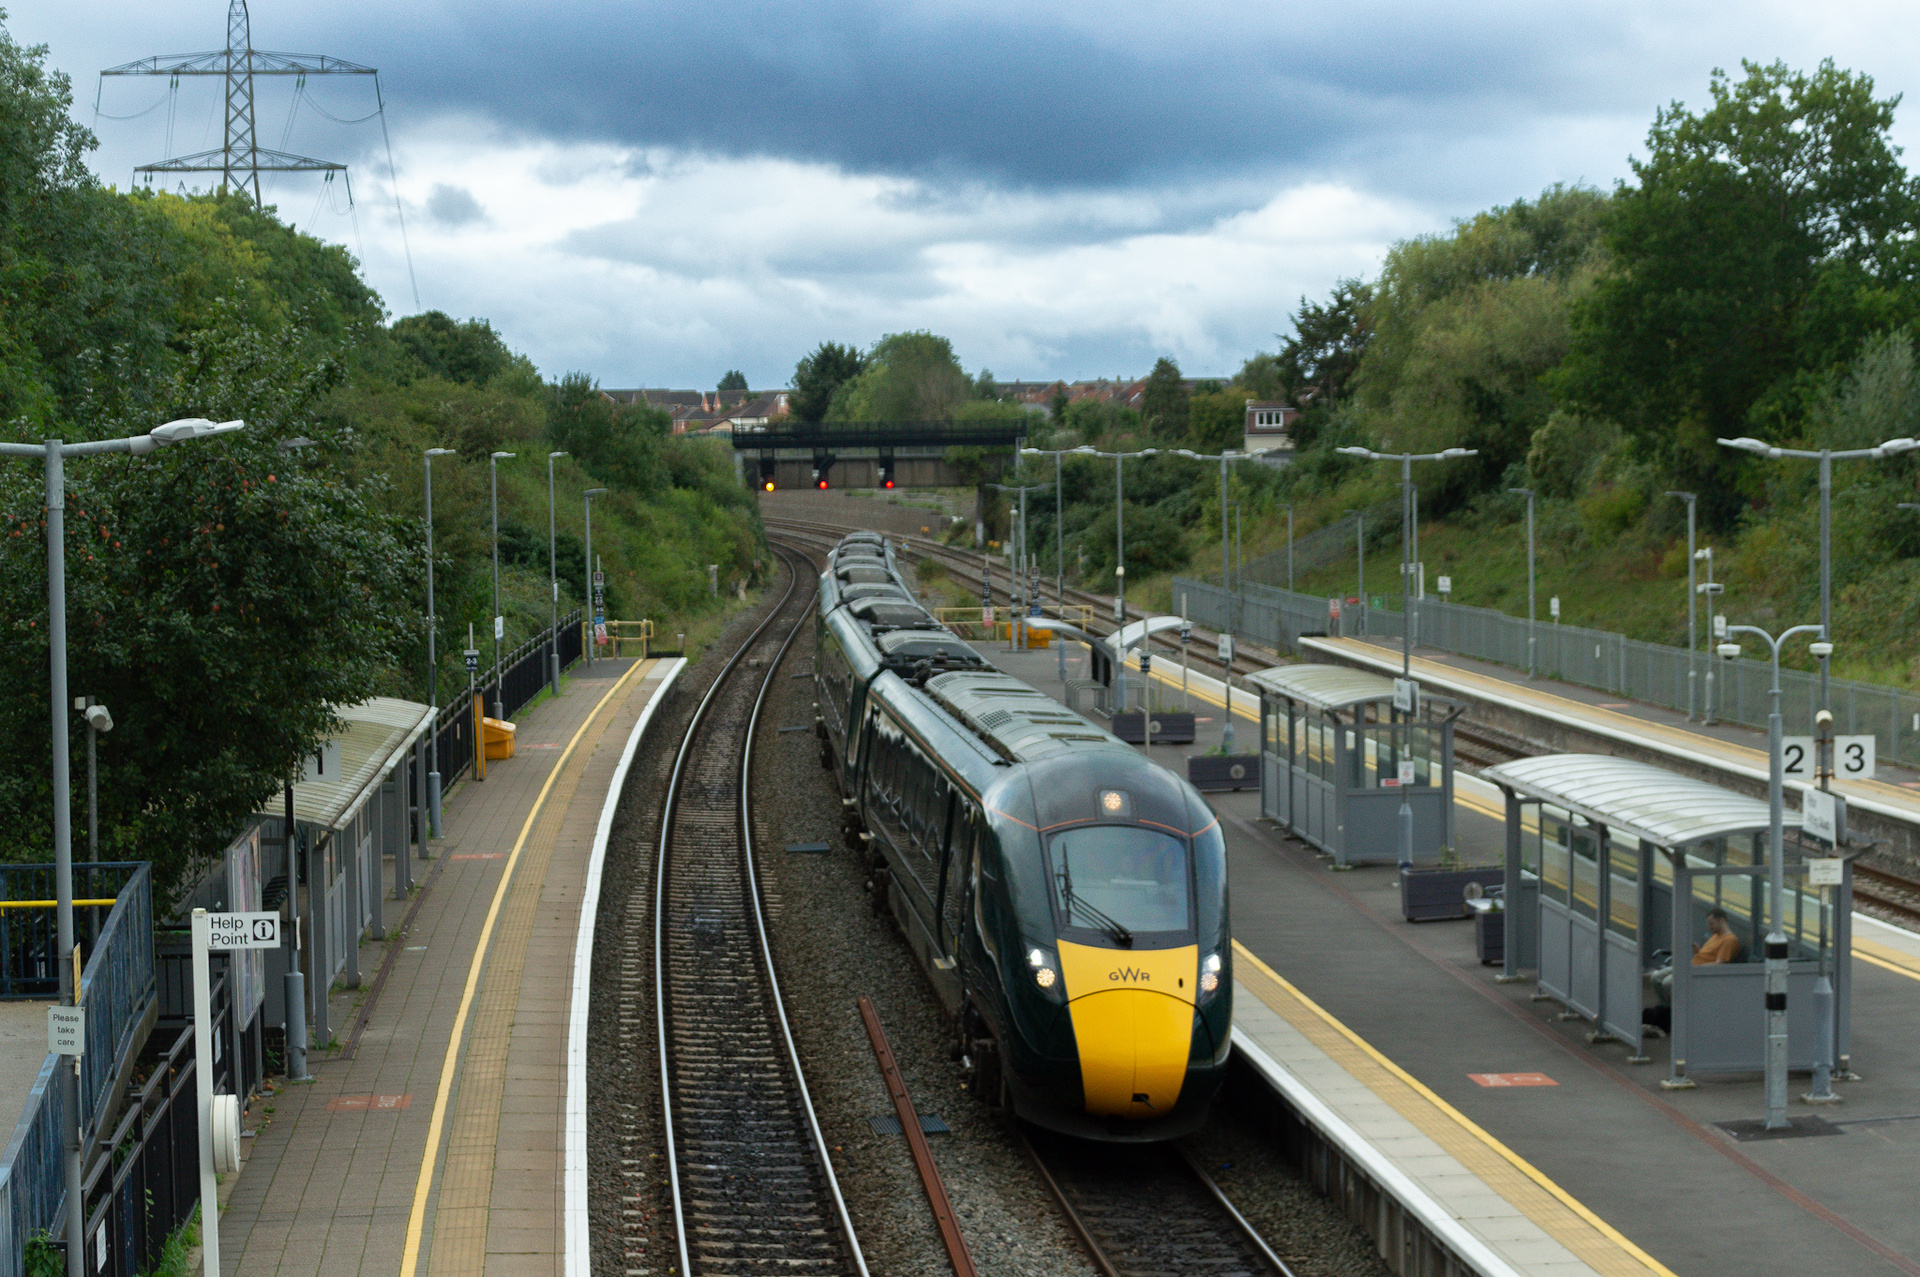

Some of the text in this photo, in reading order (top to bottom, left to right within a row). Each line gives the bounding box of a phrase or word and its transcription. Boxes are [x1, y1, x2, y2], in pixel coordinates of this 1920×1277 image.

[1784, 744, 1804, 773] 2
[1845, 743, 1865, 773] 3
[211, 916, 244, 931] Help
[211, 932, 248, 945] Point
[1109, 966, 1150, 982] GWR
[53, 1013, 79, 1022] Please
[57, 1026, 75, 1034] take
